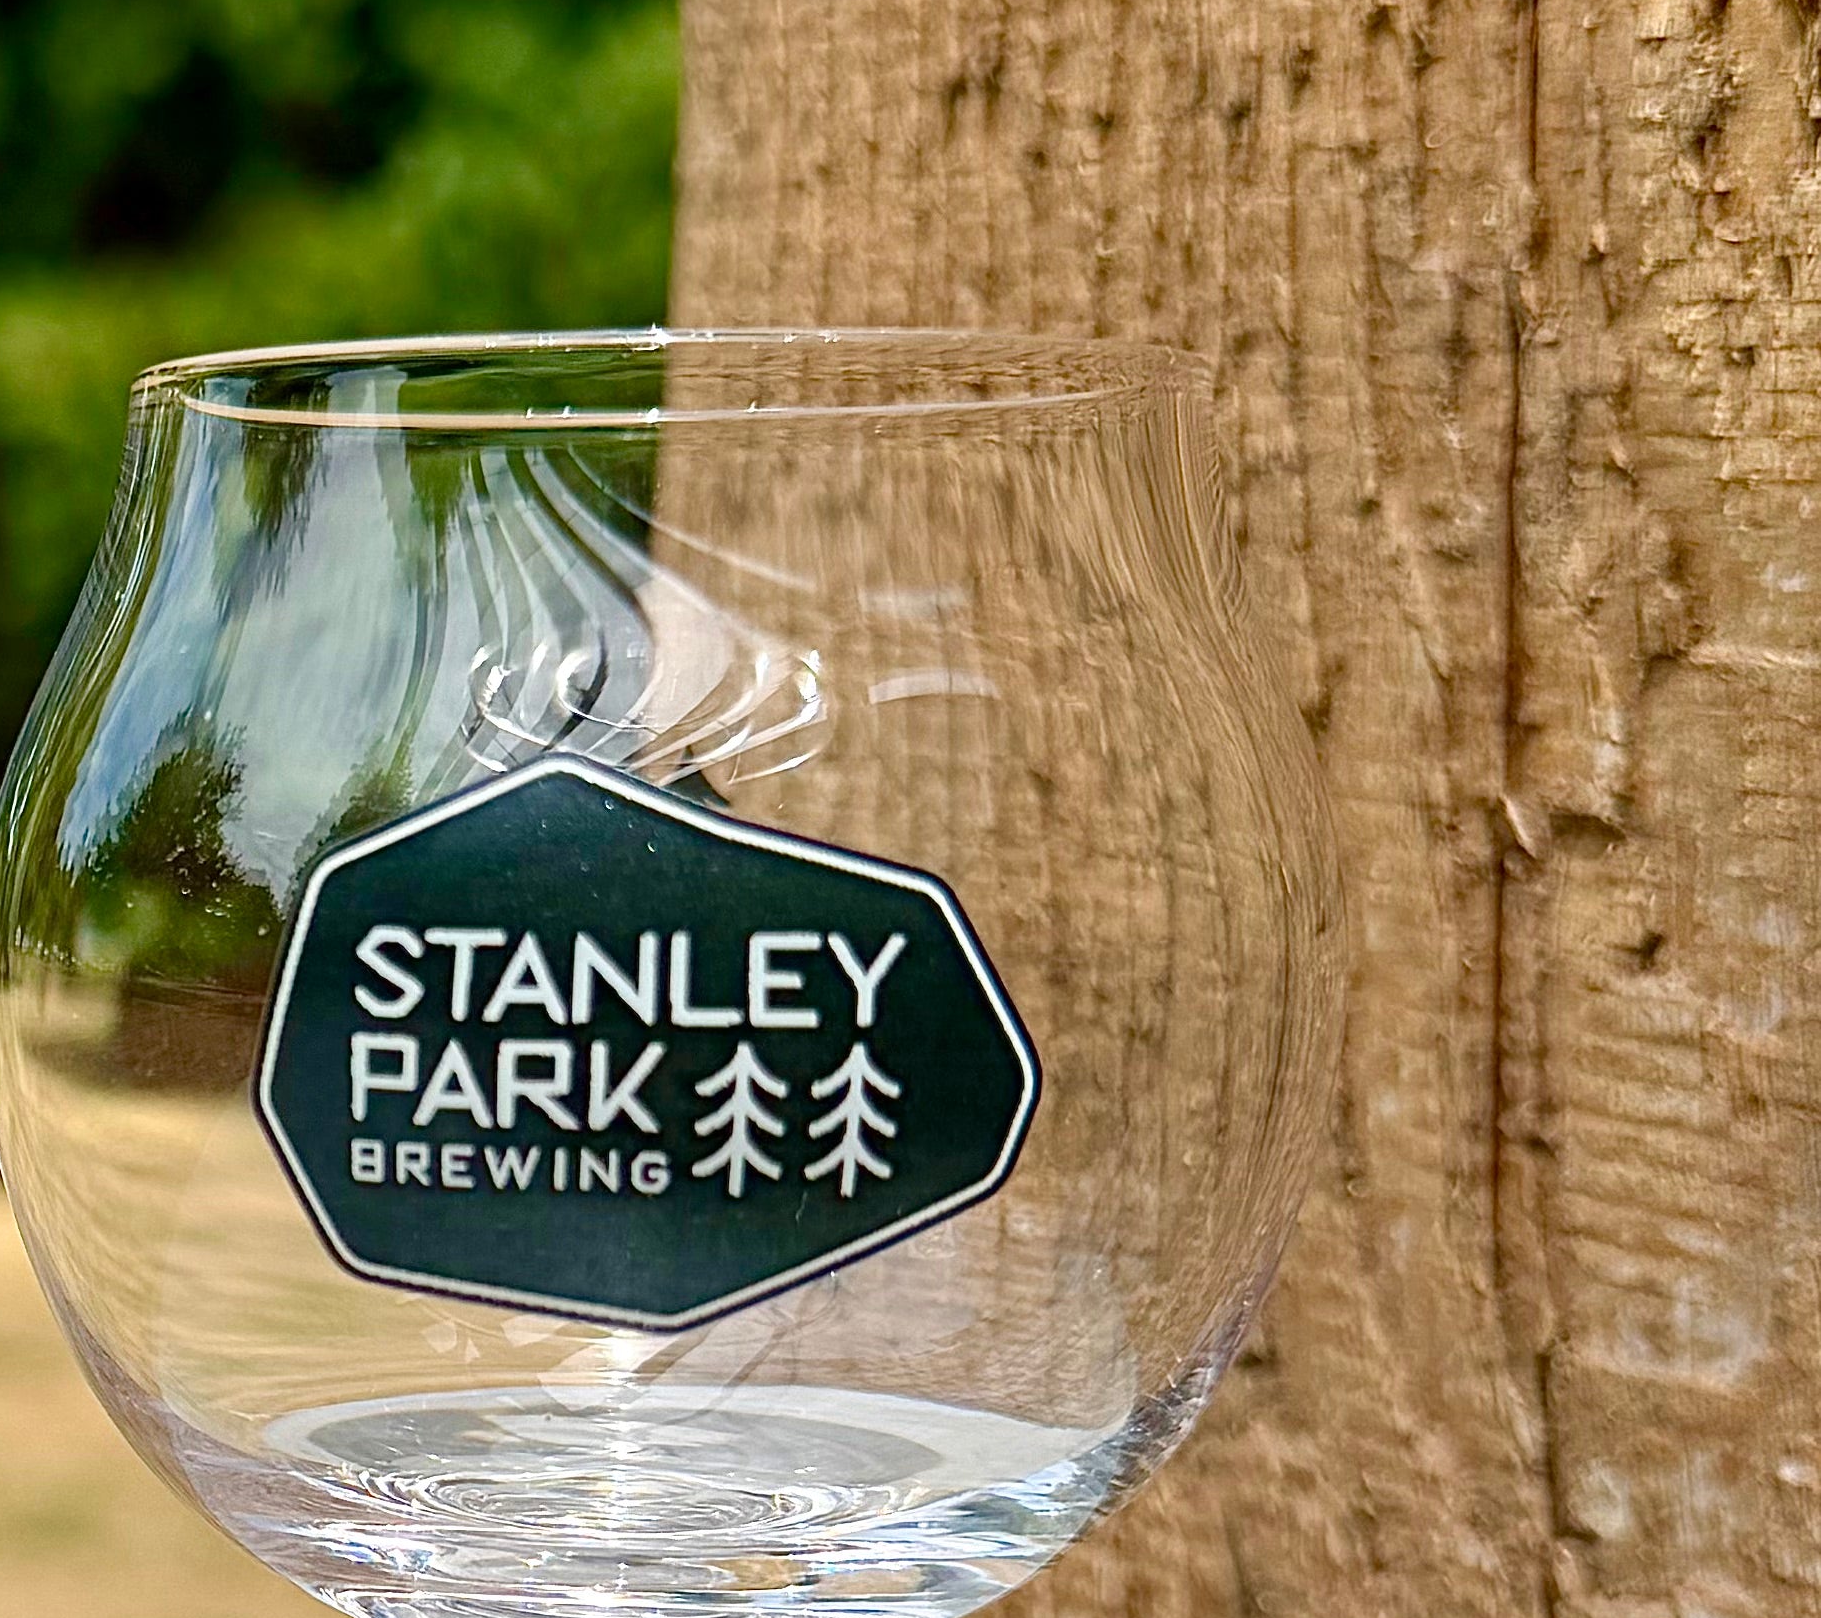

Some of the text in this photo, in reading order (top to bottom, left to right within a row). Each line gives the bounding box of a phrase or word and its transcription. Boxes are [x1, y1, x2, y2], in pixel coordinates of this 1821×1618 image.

[353, 925, 906, 1029] STANLEY
[350, 1032, 666, 1134] PARK
[349, 1138, 670, 1194] BREWING
